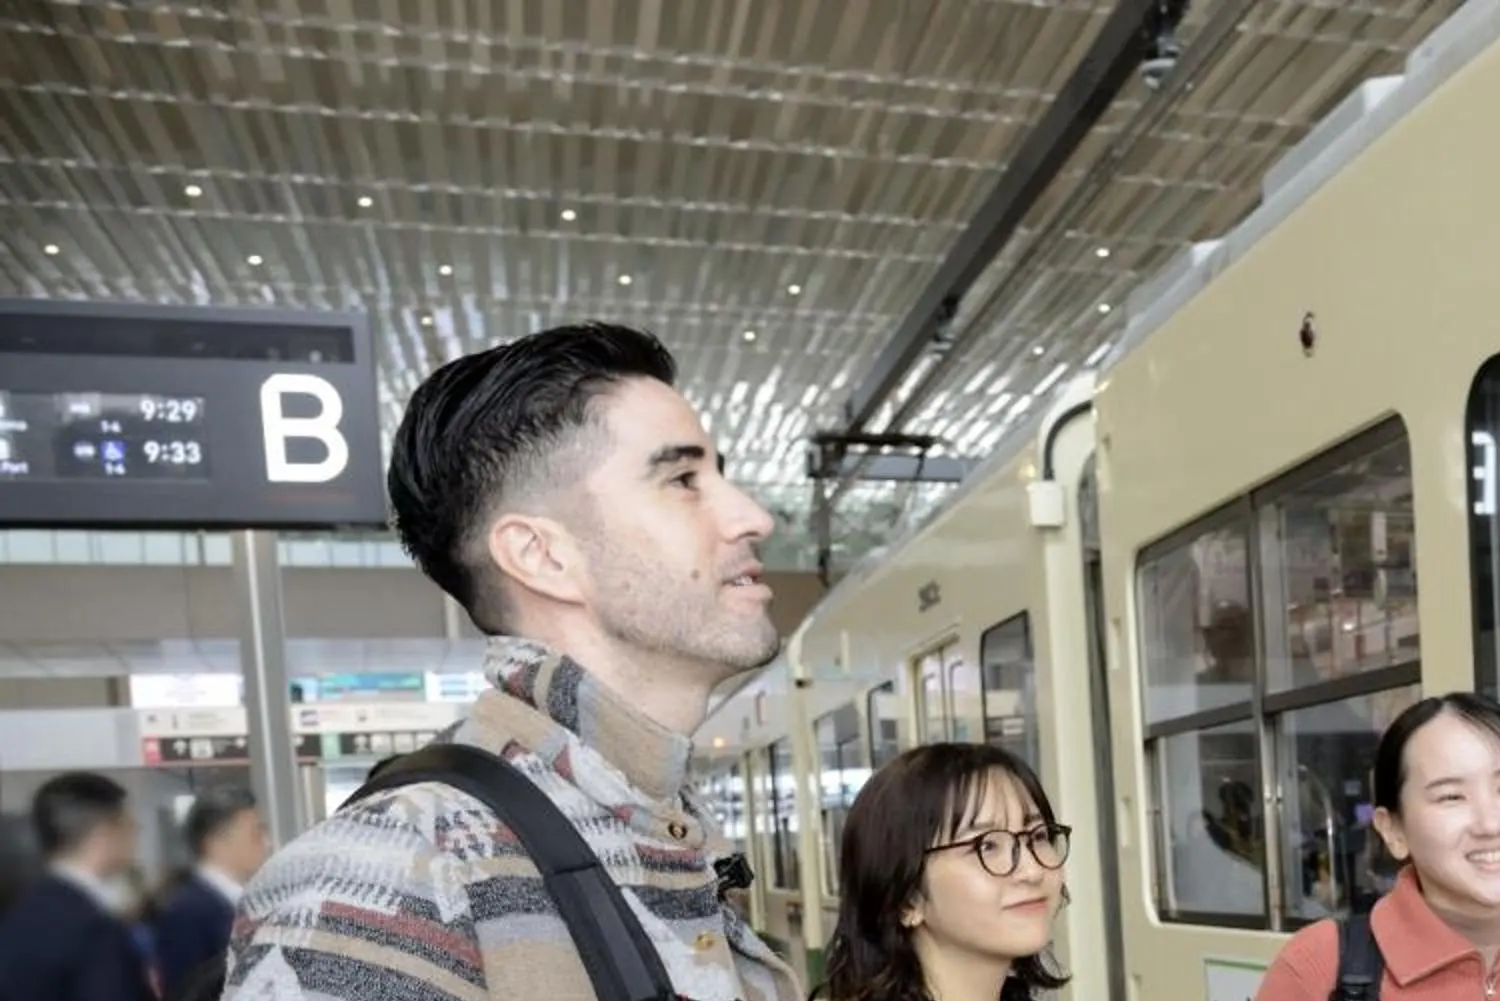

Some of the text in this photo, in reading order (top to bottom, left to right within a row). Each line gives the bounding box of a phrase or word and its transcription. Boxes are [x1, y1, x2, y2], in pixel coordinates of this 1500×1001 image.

[140, 399, 197, 422] 9:29
[259, 373, 349, 482] B
[144, 441, 201, 464] 9:33
